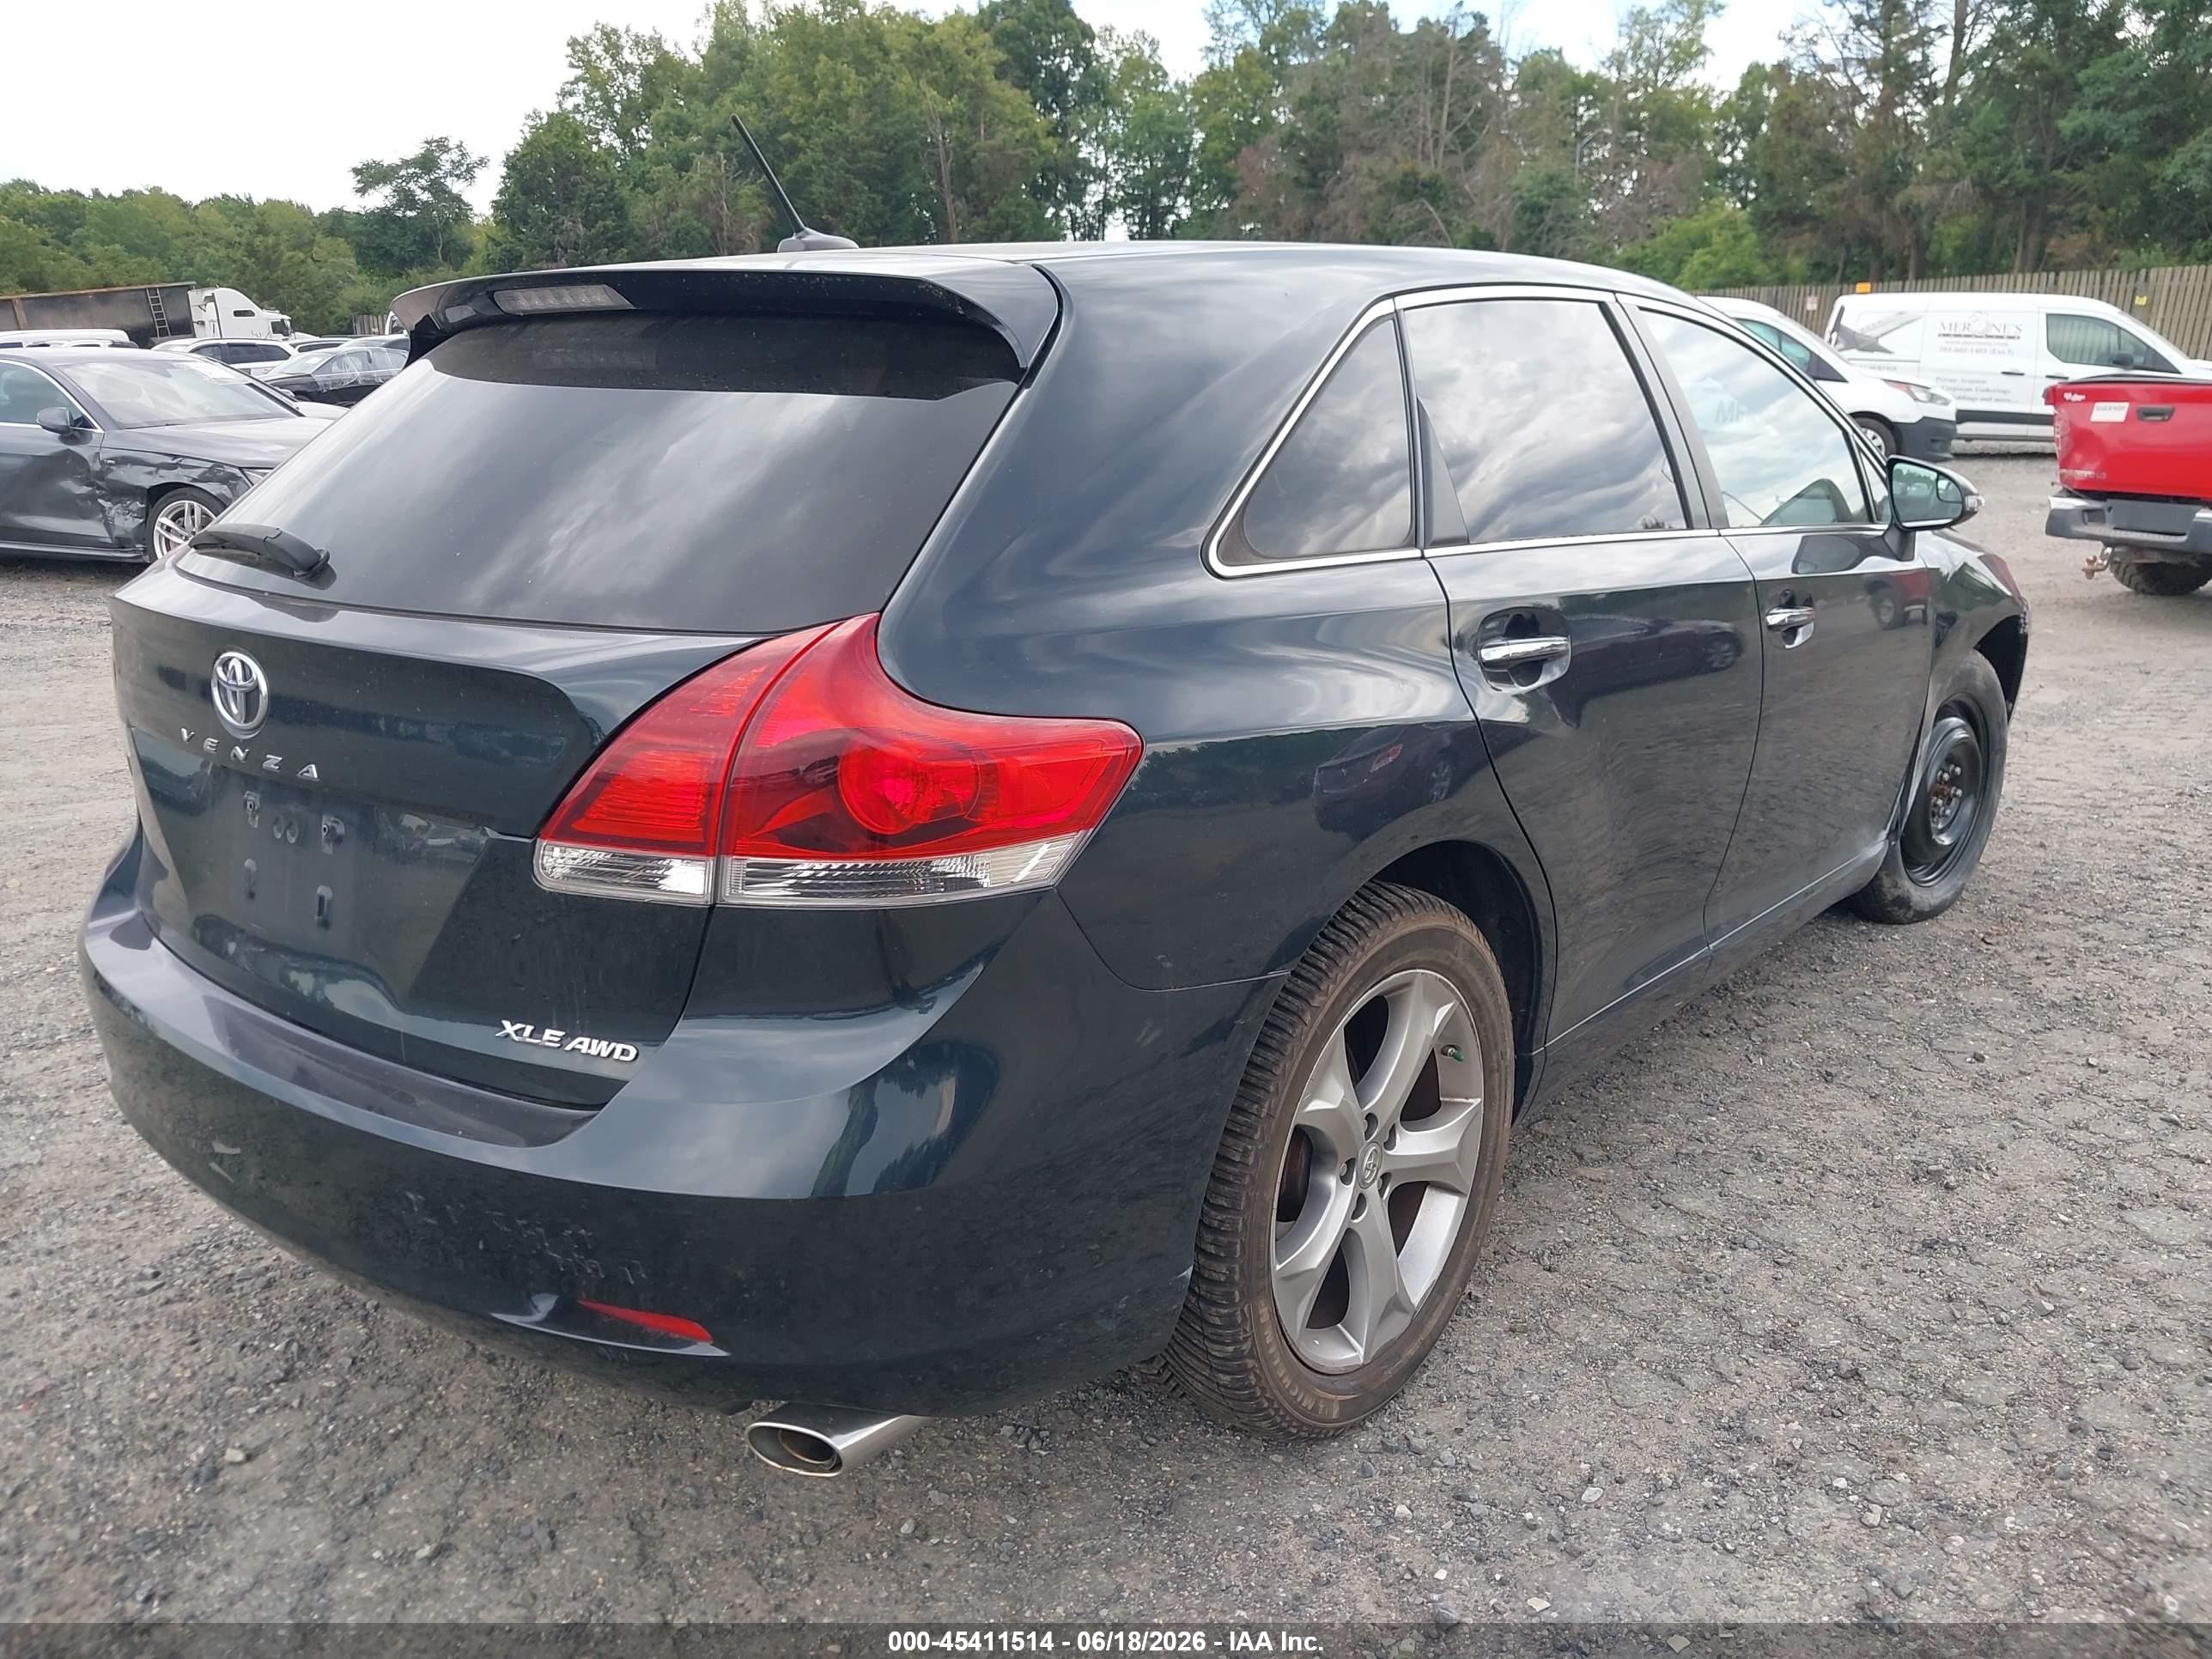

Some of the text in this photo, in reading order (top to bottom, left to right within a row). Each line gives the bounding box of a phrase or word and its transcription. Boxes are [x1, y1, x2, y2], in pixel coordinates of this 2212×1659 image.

[180, 727, 320, 781] VENZA
[495, 1019, 640, 1062] XLE AWD
